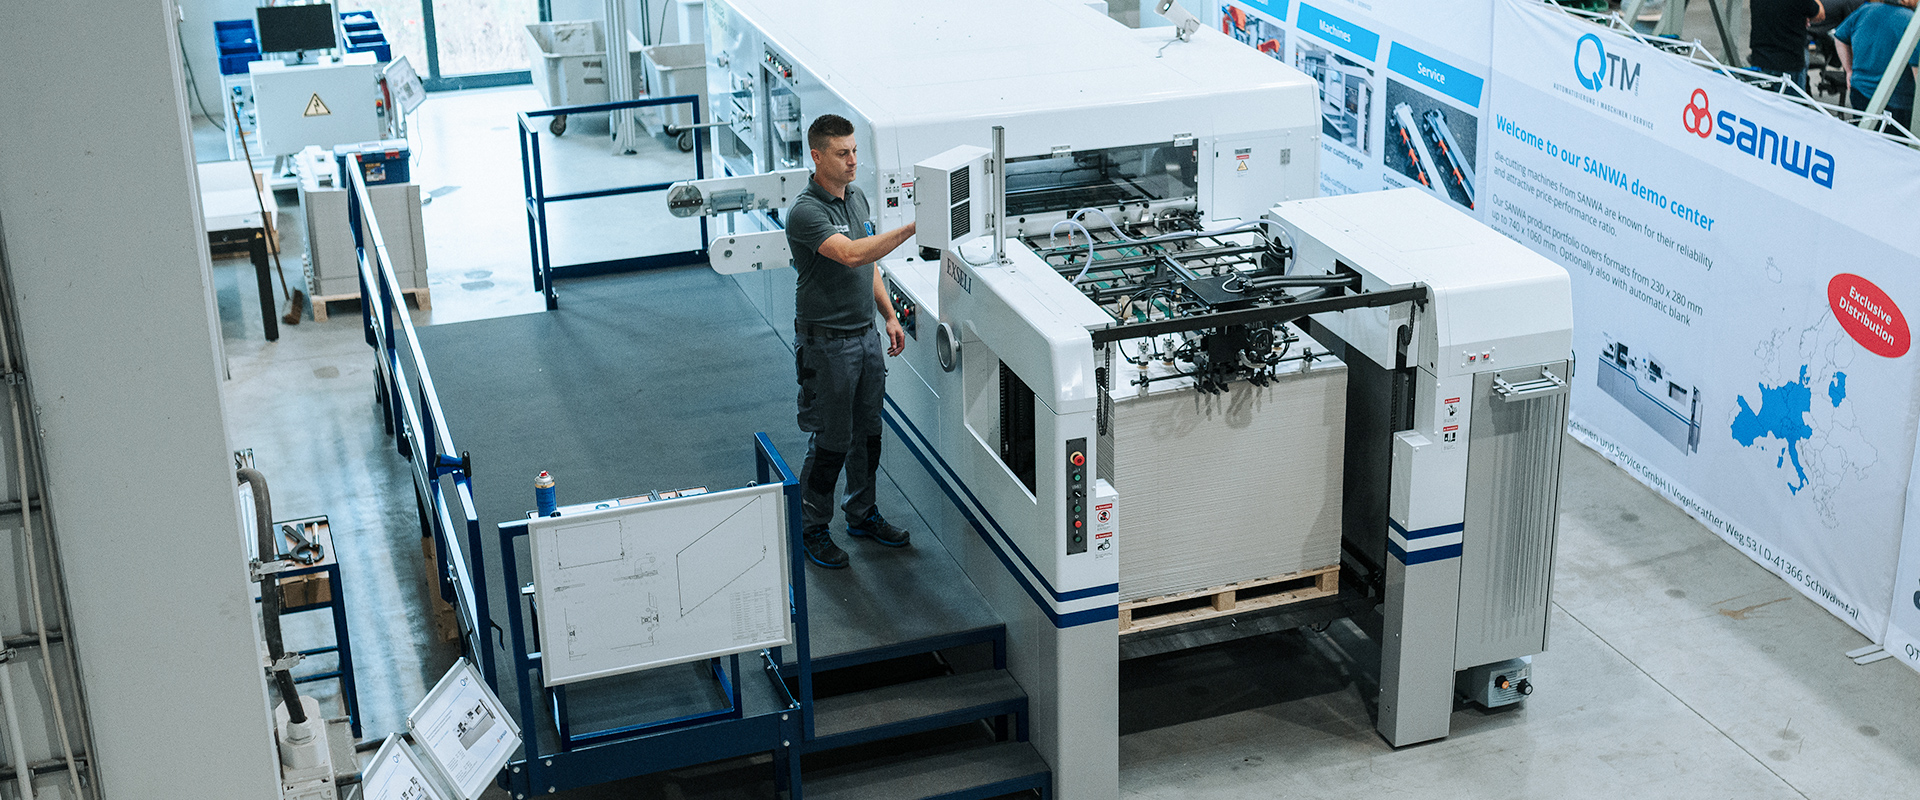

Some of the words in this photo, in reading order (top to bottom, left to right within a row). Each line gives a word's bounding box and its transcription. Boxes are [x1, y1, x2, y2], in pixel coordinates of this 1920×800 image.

[1319, 19, 1351, 43] Machines
[1574, 33, 1641, 93] QTM
[1417, 61, 1446, 85] Service
[1600, 102, 1628, 119] MASCHINEN
[1633, 116, 1654, 130] SERVICE
[1716, 110, 1835, 189] sanwa
[1494, 165, 1505, 179] and
[1506, 173, 1535, 195] attractive
[1536, 188, 1597, 227] price-performance
[1598, 219, 1617, 237] ratio.
[1496, 114, 1544, 151] Welcome
[1546, 140, 1558, 157] to
[1561, 149, 1581, 168] our
[1583, 156, 1628, 191] SANWA
[1631, 178, 1667, 209] demo
[1670, 200, 1715, 232] center
[1494, 150, 1527, 178] die-cutting
[1527, 167, 1558, 191] machines
[1559, 182, 1576, 199] from
[1577, 191, 1603, 213] SANWA
[1604, 207, 1617, 220] are
[1618, 211, 1643, 233] known
[1644, 224, 1655, 239] for
[1656, 232, 1675, 249] their
[1676, 241, 1714, 271] reliability
[1491, 210, 1500, 222] up
[1500, 214, 1508, 225] to
[1509, 217, 1520, 232] 740
[1521, 227, 1526, 235] x
[1527, 228, 1542, 245] 1060
[1543, 239, 1558, 254] mm.
[1559, 246, 1595, 276] Optionally
[1595, 267, 1611, 282] also
[1611, 275, 1628, 292] with
[1628, 285, 1668, 314] automatic
[1668, 304, 1690, 327] blank
[1492, 193, 1503, 207] Our
[1504, 200, 1526, 220] SANWA
[1527, 215, 1551, 235] product
[1552, 228, 1580, 250] portfolio
[1580, 243, 1603, 262] covers
[1603, 253, 1631, 277] formats
[1631, 268, 1650, 287] from
[1650, 278, 1665, 295] 230
[1665, 289, 1671, 299] x
[1671, 290, 1687, 306] 280
[1687, 300, 1703, 316] mm
[1839, 296, 1894, 346] Distribution
[1849, 286, 1892, 326] Exclusive
[1568, 420, 1599, 442] schinen
[1600, 438, 1615, 453] und
[1615, 446, 1640, 473] Service
[1642, 465, 1667, 490] GmbH
[1725, 522, 1745, 546] Weg
[1746, 536, 1757, 552] 53
[1764, 548, 1803, 582] D-41366
